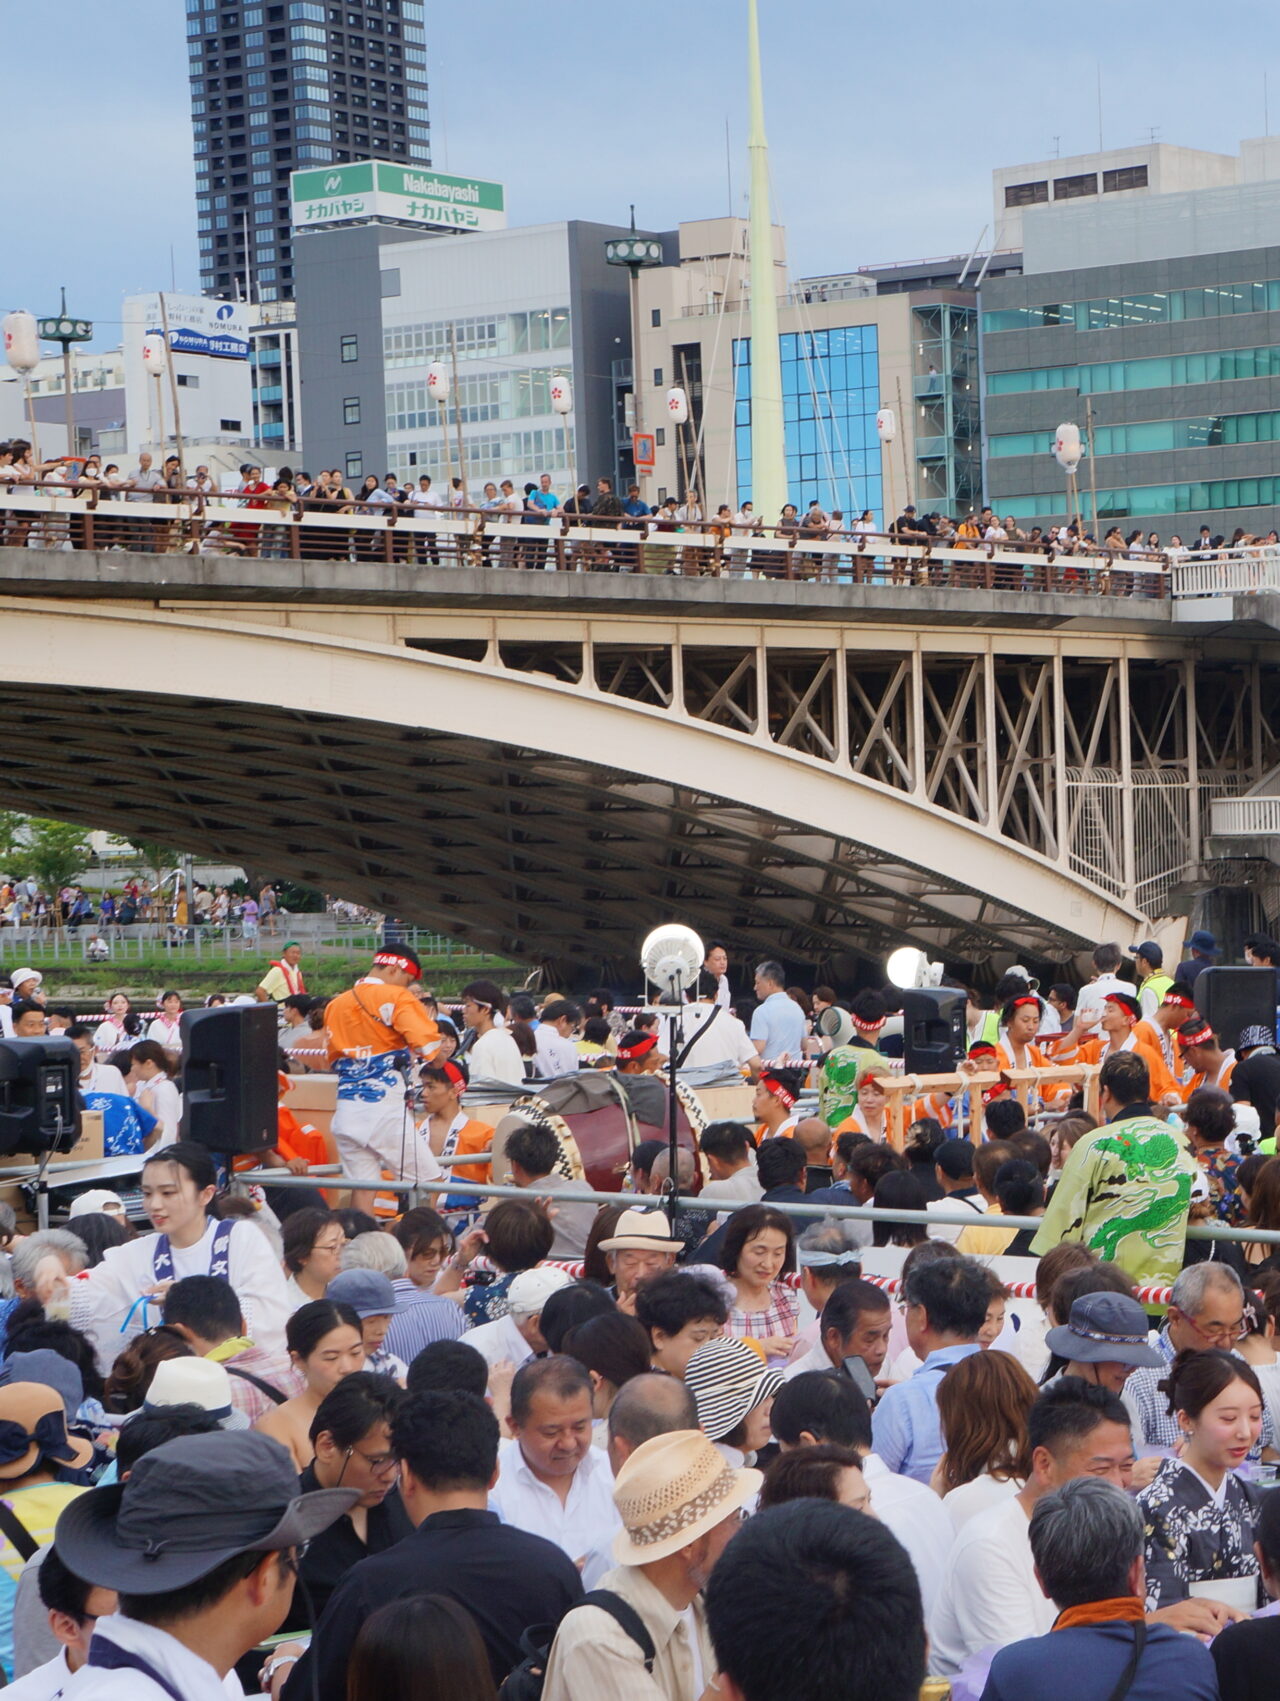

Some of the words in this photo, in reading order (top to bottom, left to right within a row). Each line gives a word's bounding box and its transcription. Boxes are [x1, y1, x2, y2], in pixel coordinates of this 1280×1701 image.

[403, 173, 479, 203] Nakabayashi
[305, 198, 364, 220] ナカバヤシ
[406, 201, 479, 226] ナカバヤシ
[208, 321, 243, 332] NOMURA
